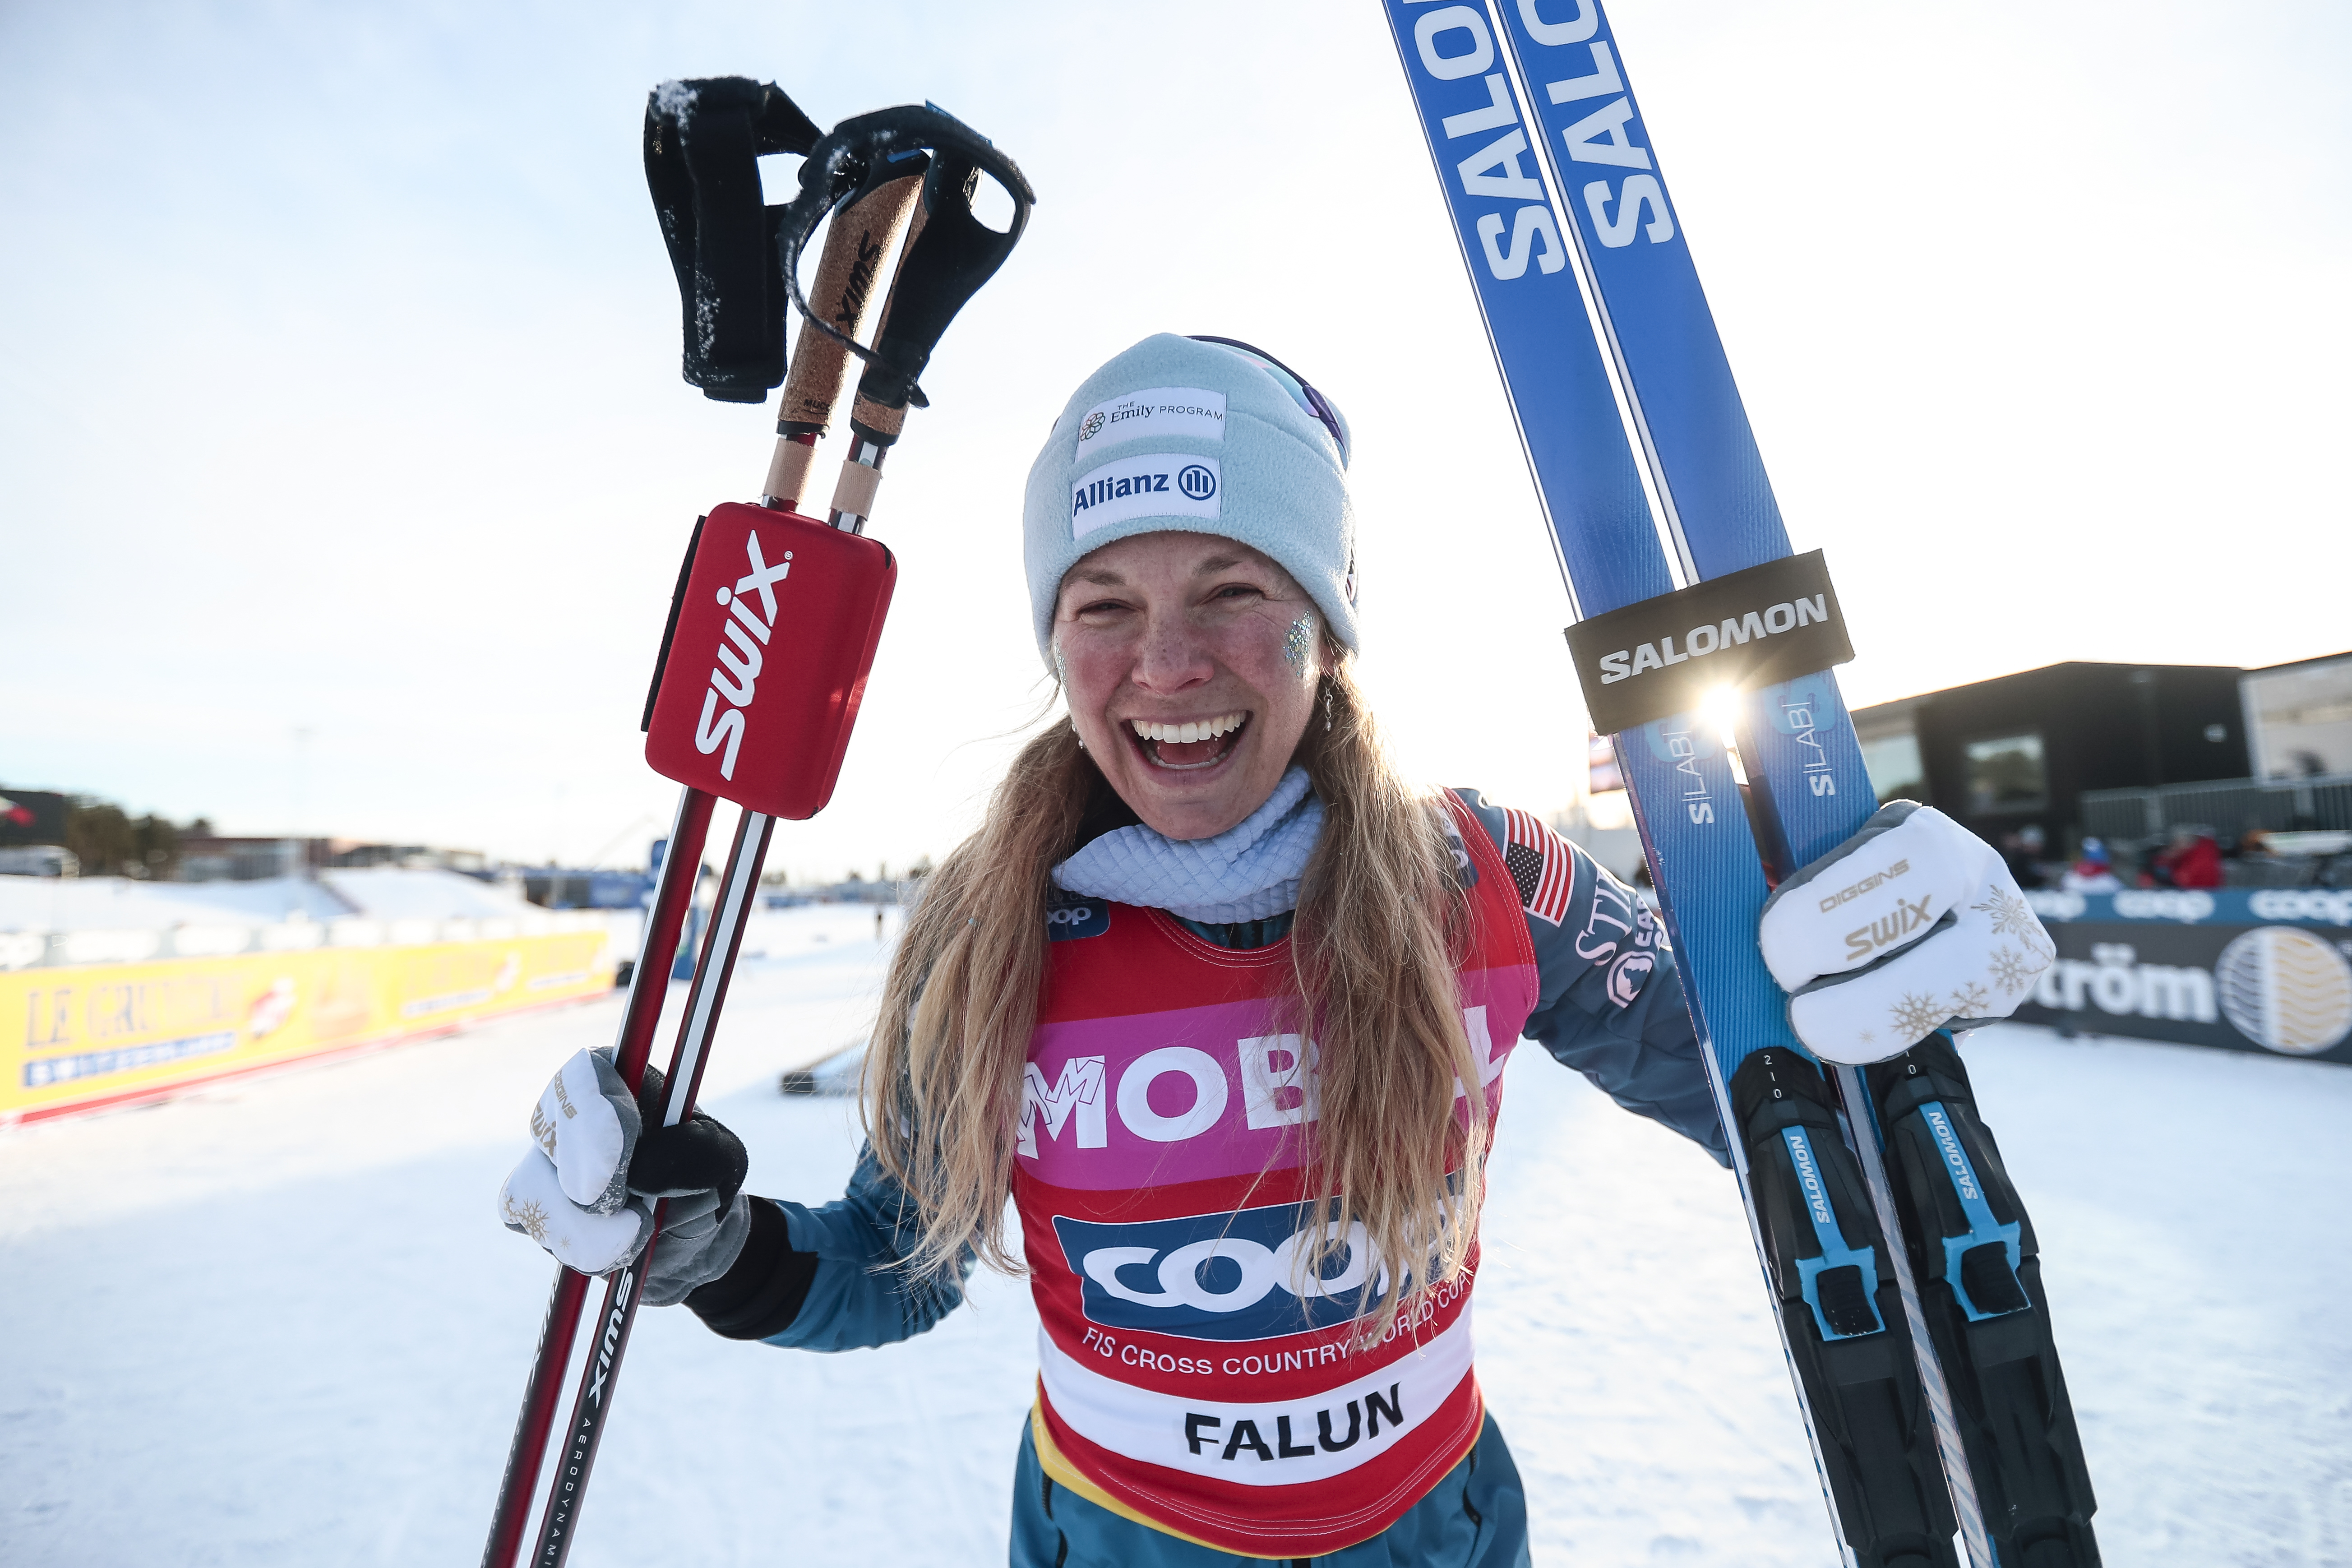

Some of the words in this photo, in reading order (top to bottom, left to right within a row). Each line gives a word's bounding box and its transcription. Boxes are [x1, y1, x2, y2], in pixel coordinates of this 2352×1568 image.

[1402, 0, 1566, 280] SALO
[1110, 405, 1155, 423] Emily
[1160, 405, 1223, 422] PROGRAM
[1118, 401, 1135, 410] THE
[1072, 474, 1169, 518] Allianz
[1599, 593, 1828, 685] SALOMON
[1820, 859, 1910, 913] DIGGINS
[1764, 1055, 1773, 1065] 2
[1789, 1136, 1831, 1224] SALOMON
[1929, 1112, 1979, 1200] SALOMON
[1081, 1326, 1114, 1358] FIS
[1121, 1345, 1213, 1375] CROSS
[1222, 1337, 1351, 1375] COUNTRY
[1184, 1382, 1405, 1462] FALUN
